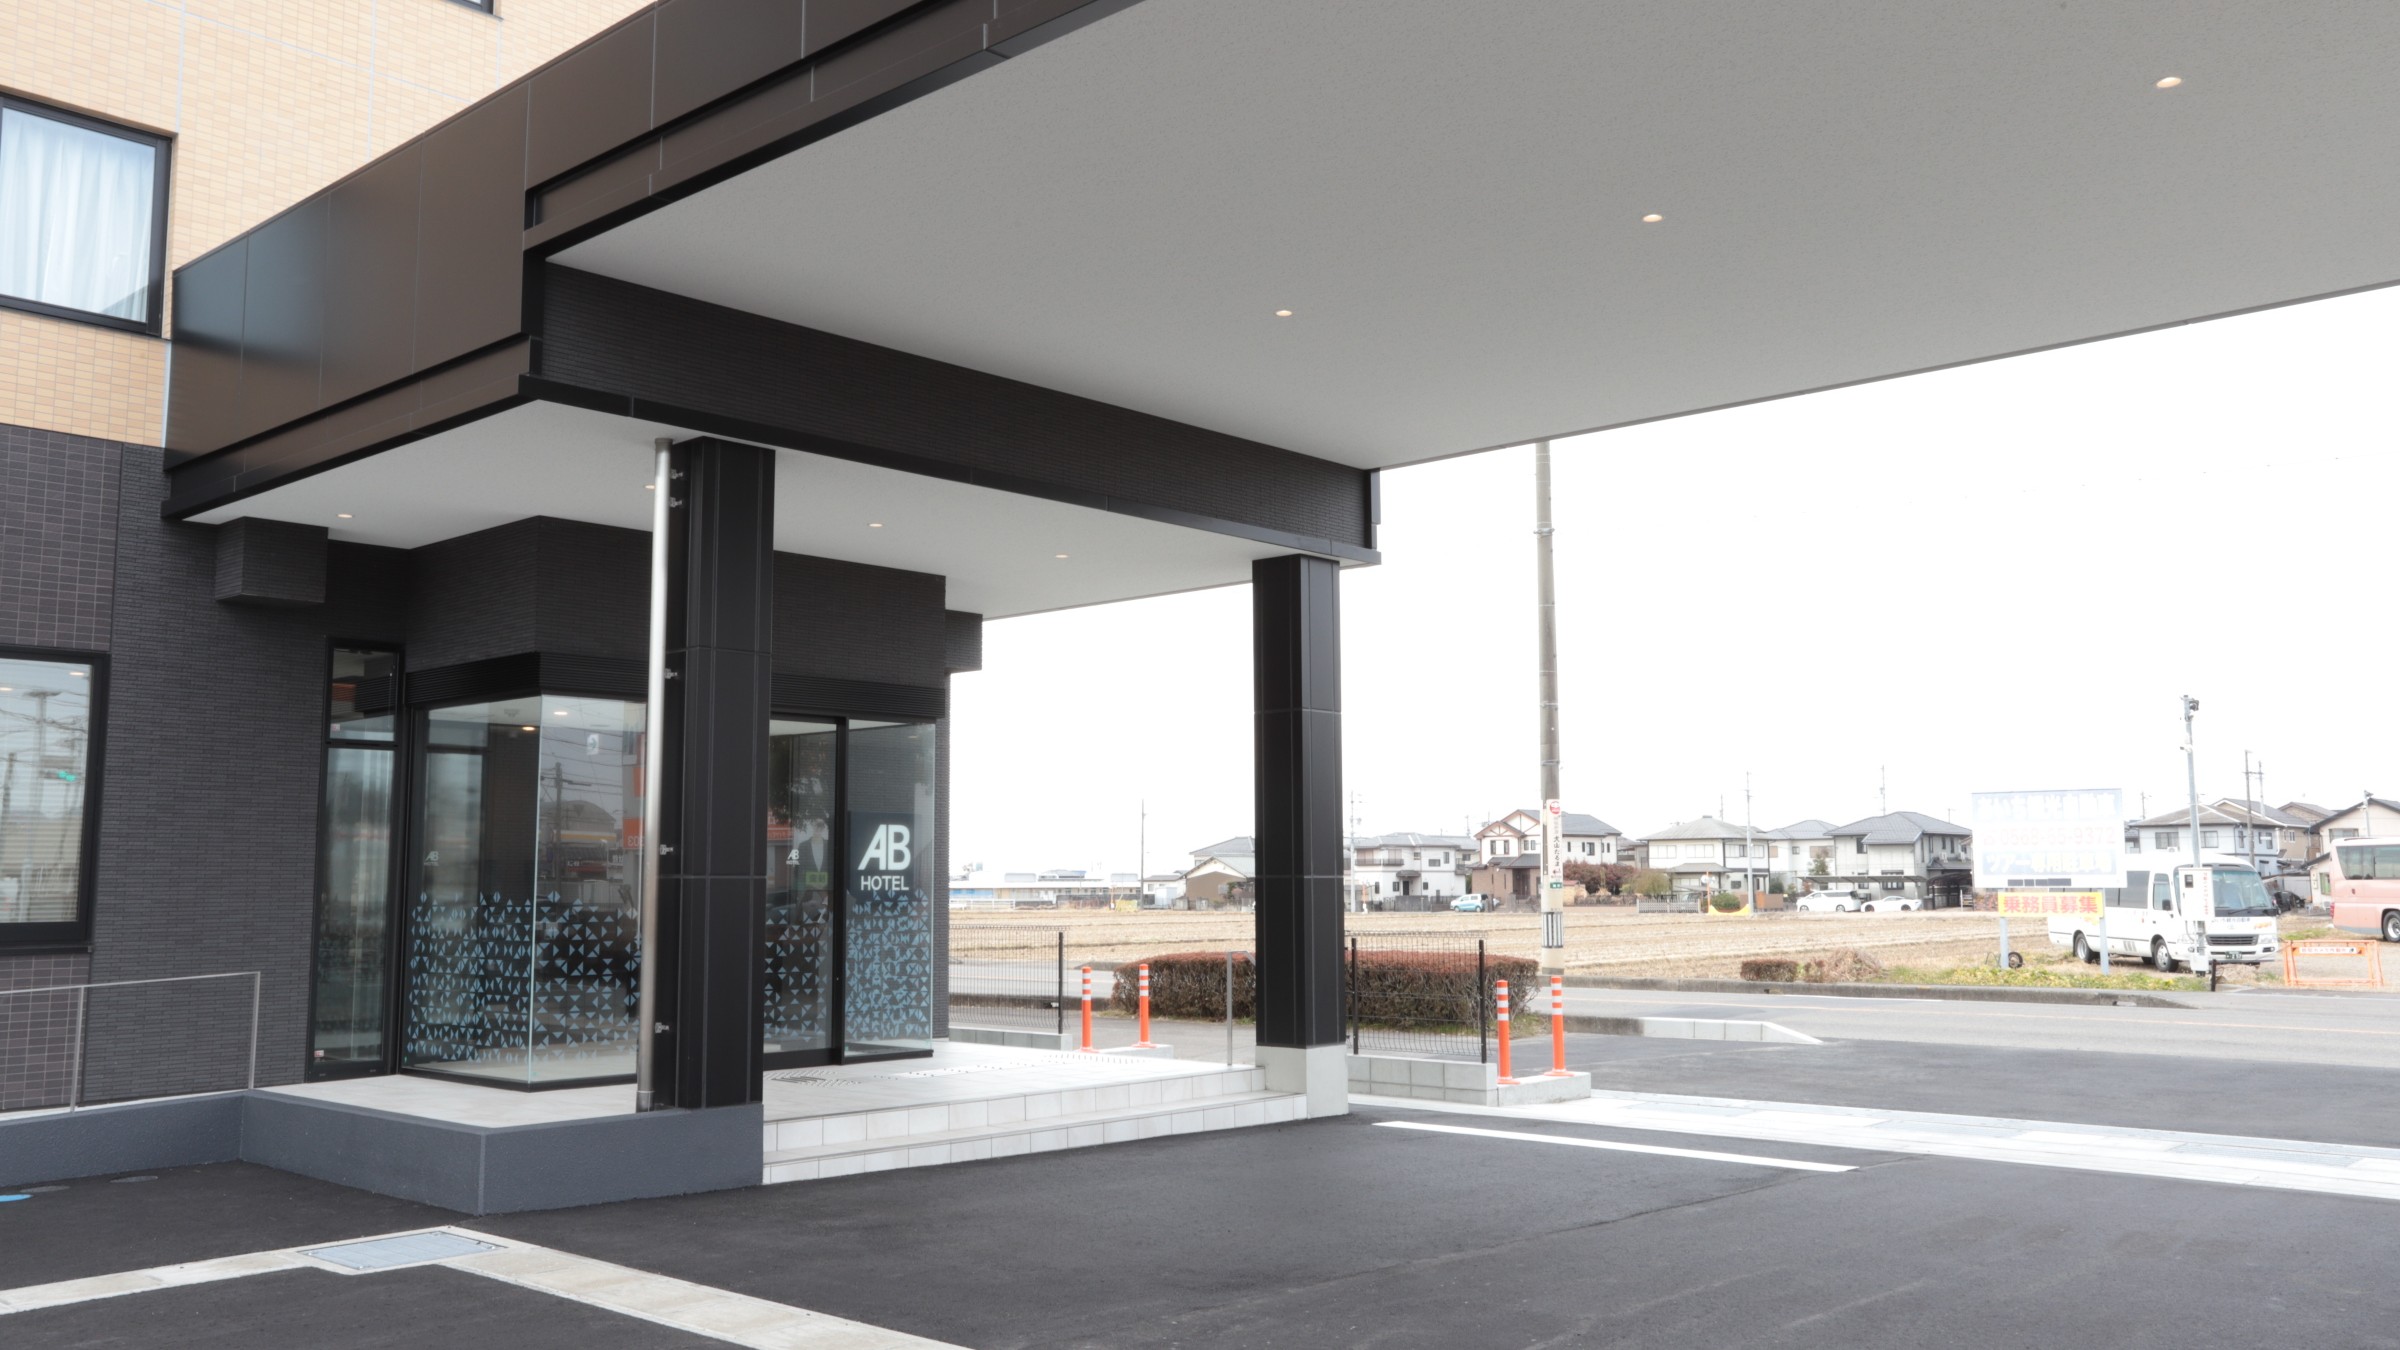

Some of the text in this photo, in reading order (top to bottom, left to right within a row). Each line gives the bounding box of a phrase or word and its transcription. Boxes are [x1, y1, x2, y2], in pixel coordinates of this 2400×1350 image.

[787, 849, 799, 859] AB
[857, 824, 911, 871] AB
[860, 875, 910, 891] HOTEL
[2003, 895, 2099, 914] 乗務員募集
